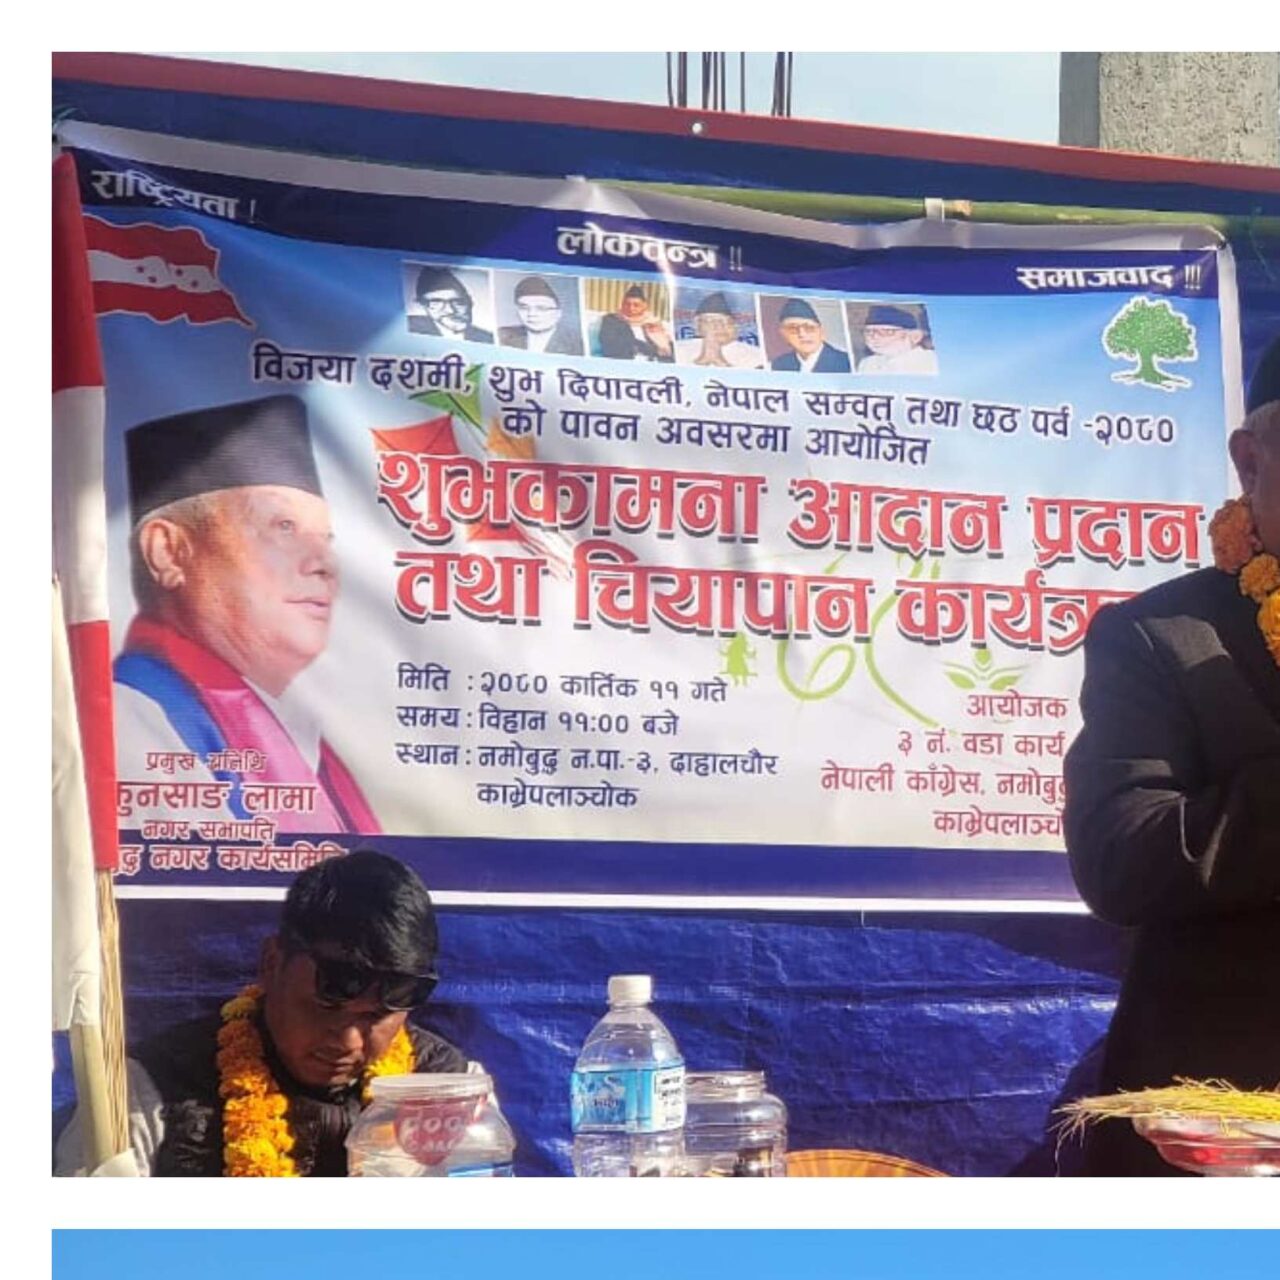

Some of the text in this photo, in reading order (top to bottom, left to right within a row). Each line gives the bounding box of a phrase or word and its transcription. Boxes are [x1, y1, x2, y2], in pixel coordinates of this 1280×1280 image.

[1016, 265, 1174, 290] समाजवाद
[253, 343, 356, 384] विजया
[370, 353, 472, 392] दशमी,
[488, 365, 544, 400] शुभ
[557, 369, 692, 407] दिपावली,
[704, 380, 789, 412] नेपाल
[906, 396, 960, 427] तथा
[973, 403, 1020, 433] छठ
[1032, 406, 1070, 438] पर्व
[504, 403, 931, 466] को पावन अवसरमा आयोजित
[376, 451, 1205, 569] शुभकामना आदान प्रदान
[394, 551, 551, 627] तथा
[571, 539, 874, 643] चियापान
[397, 661, 451, 692] मिति
[560, 673, 641, 699] कार्तिक
[650, 680, 679, 700] ११
[690, 676, 728, 703] गते
[966, 689, 1069, 718] आयोजक
[396, 705, 462, 730] समय
[641, 708, 680, 736] बजे
[395, 743, 461, 766] स्थान
[898, 730, 913, 756] ३
[962, 732, 1004, 756] वडा
[1013, 731, 1066, 758] कार्य
[145, 752, 196, 774] प्रमुख
[820, 760, 896, 792] नेपाली
[242, 783, 317, 812] लामा
[143, 816, 276, 841] नगर सभापति
[151, 845, 211, 870] नगर
